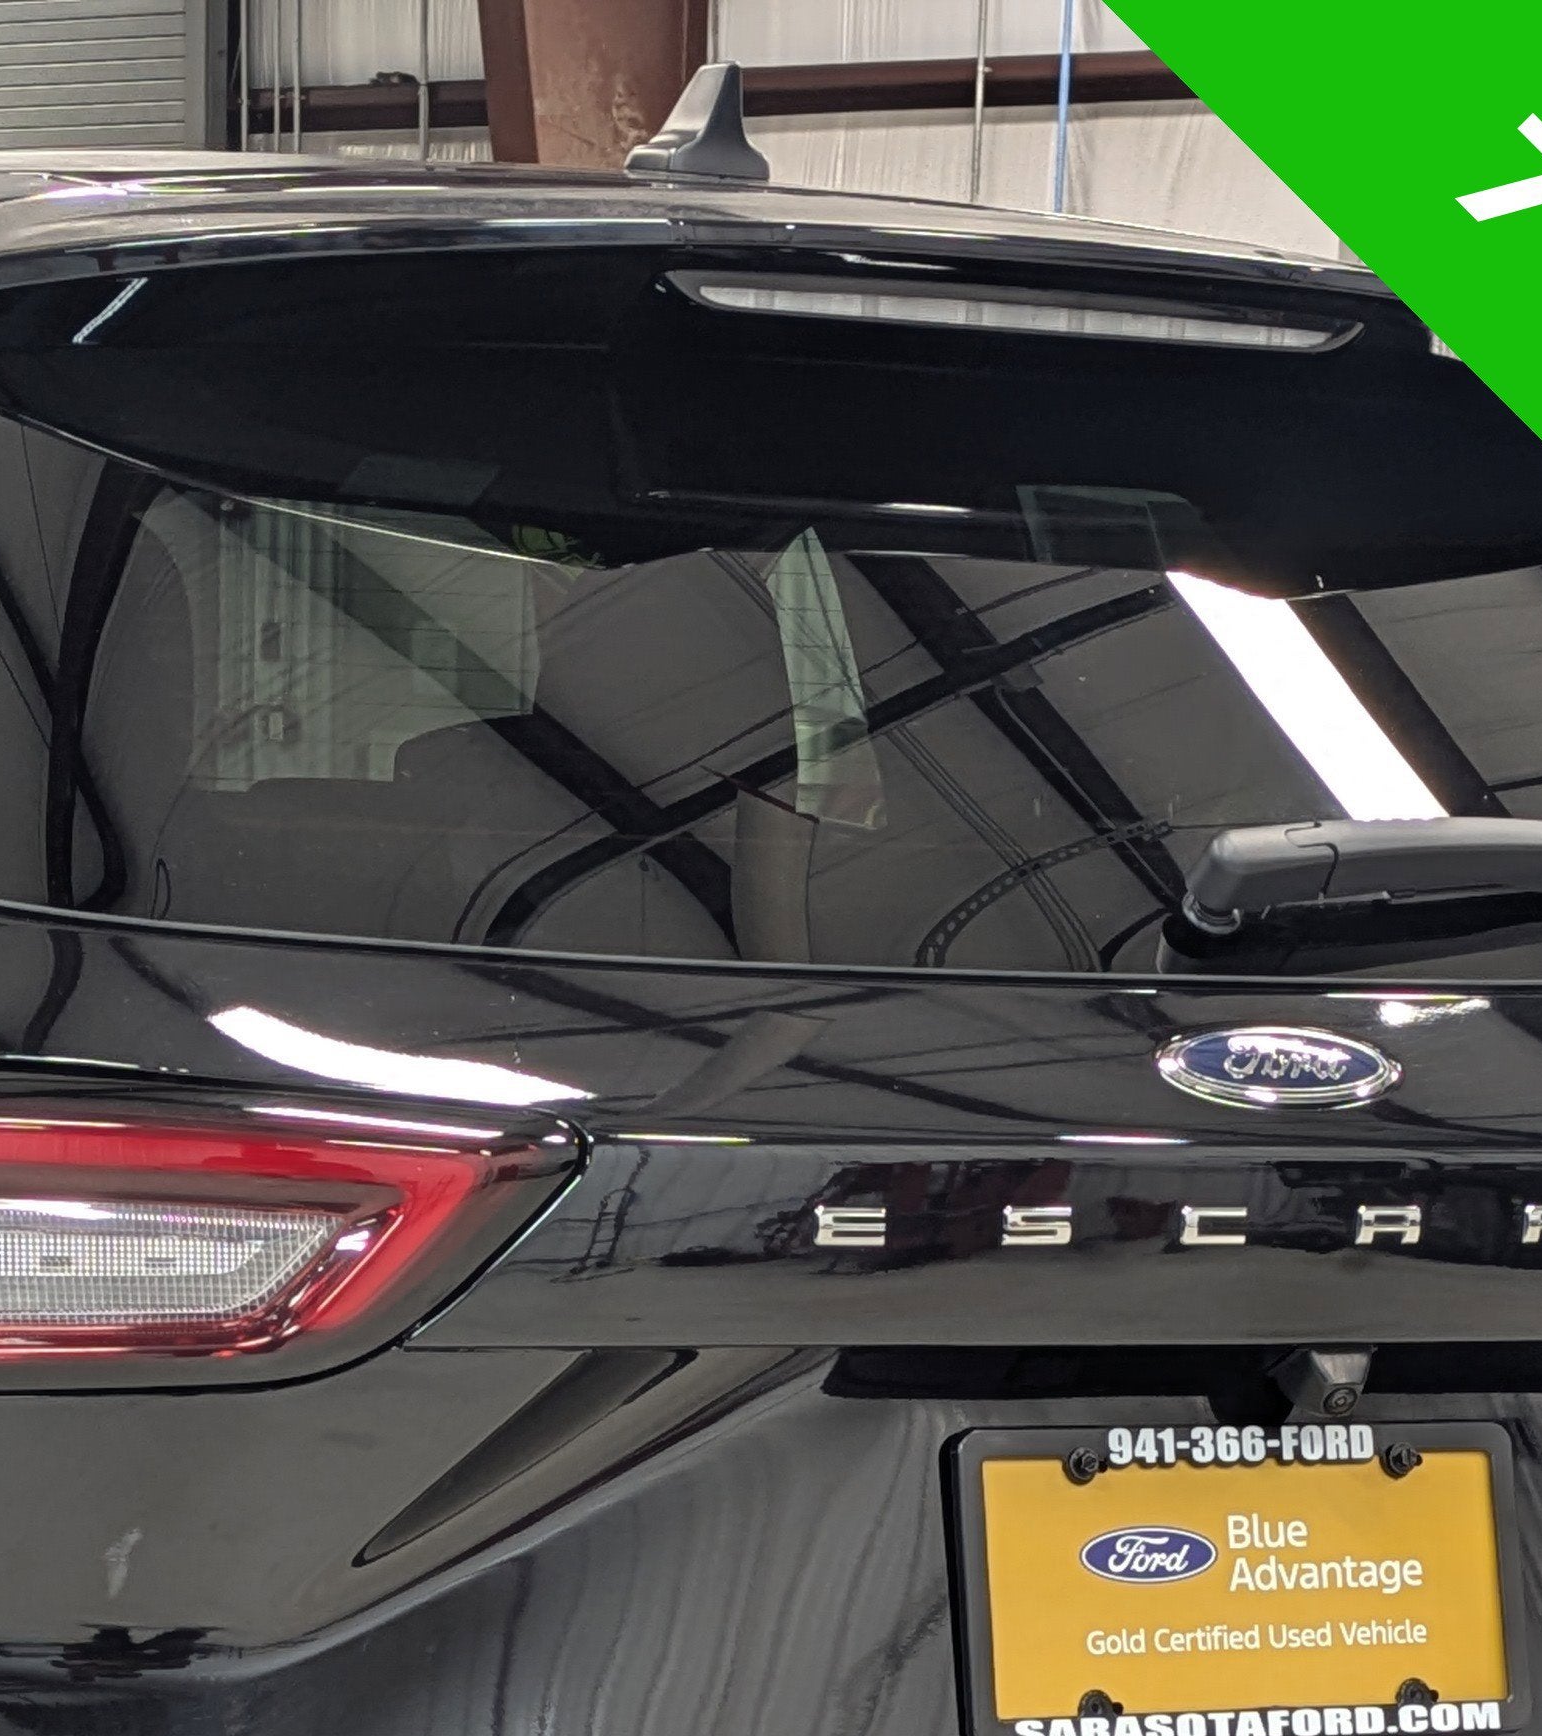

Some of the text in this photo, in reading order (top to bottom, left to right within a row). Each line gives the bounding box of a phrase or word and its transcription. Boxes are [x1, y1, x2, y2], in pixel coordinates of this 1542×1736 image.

[1108, 1424, 1375, 1465] 941-366-FORD
[1227, 1512, 1309, 1550] Blue
[1228, 1554, 1424, 1595] Advantage
[1086, 1617, 1428, 1656] Gold Certified Used Vehicle
